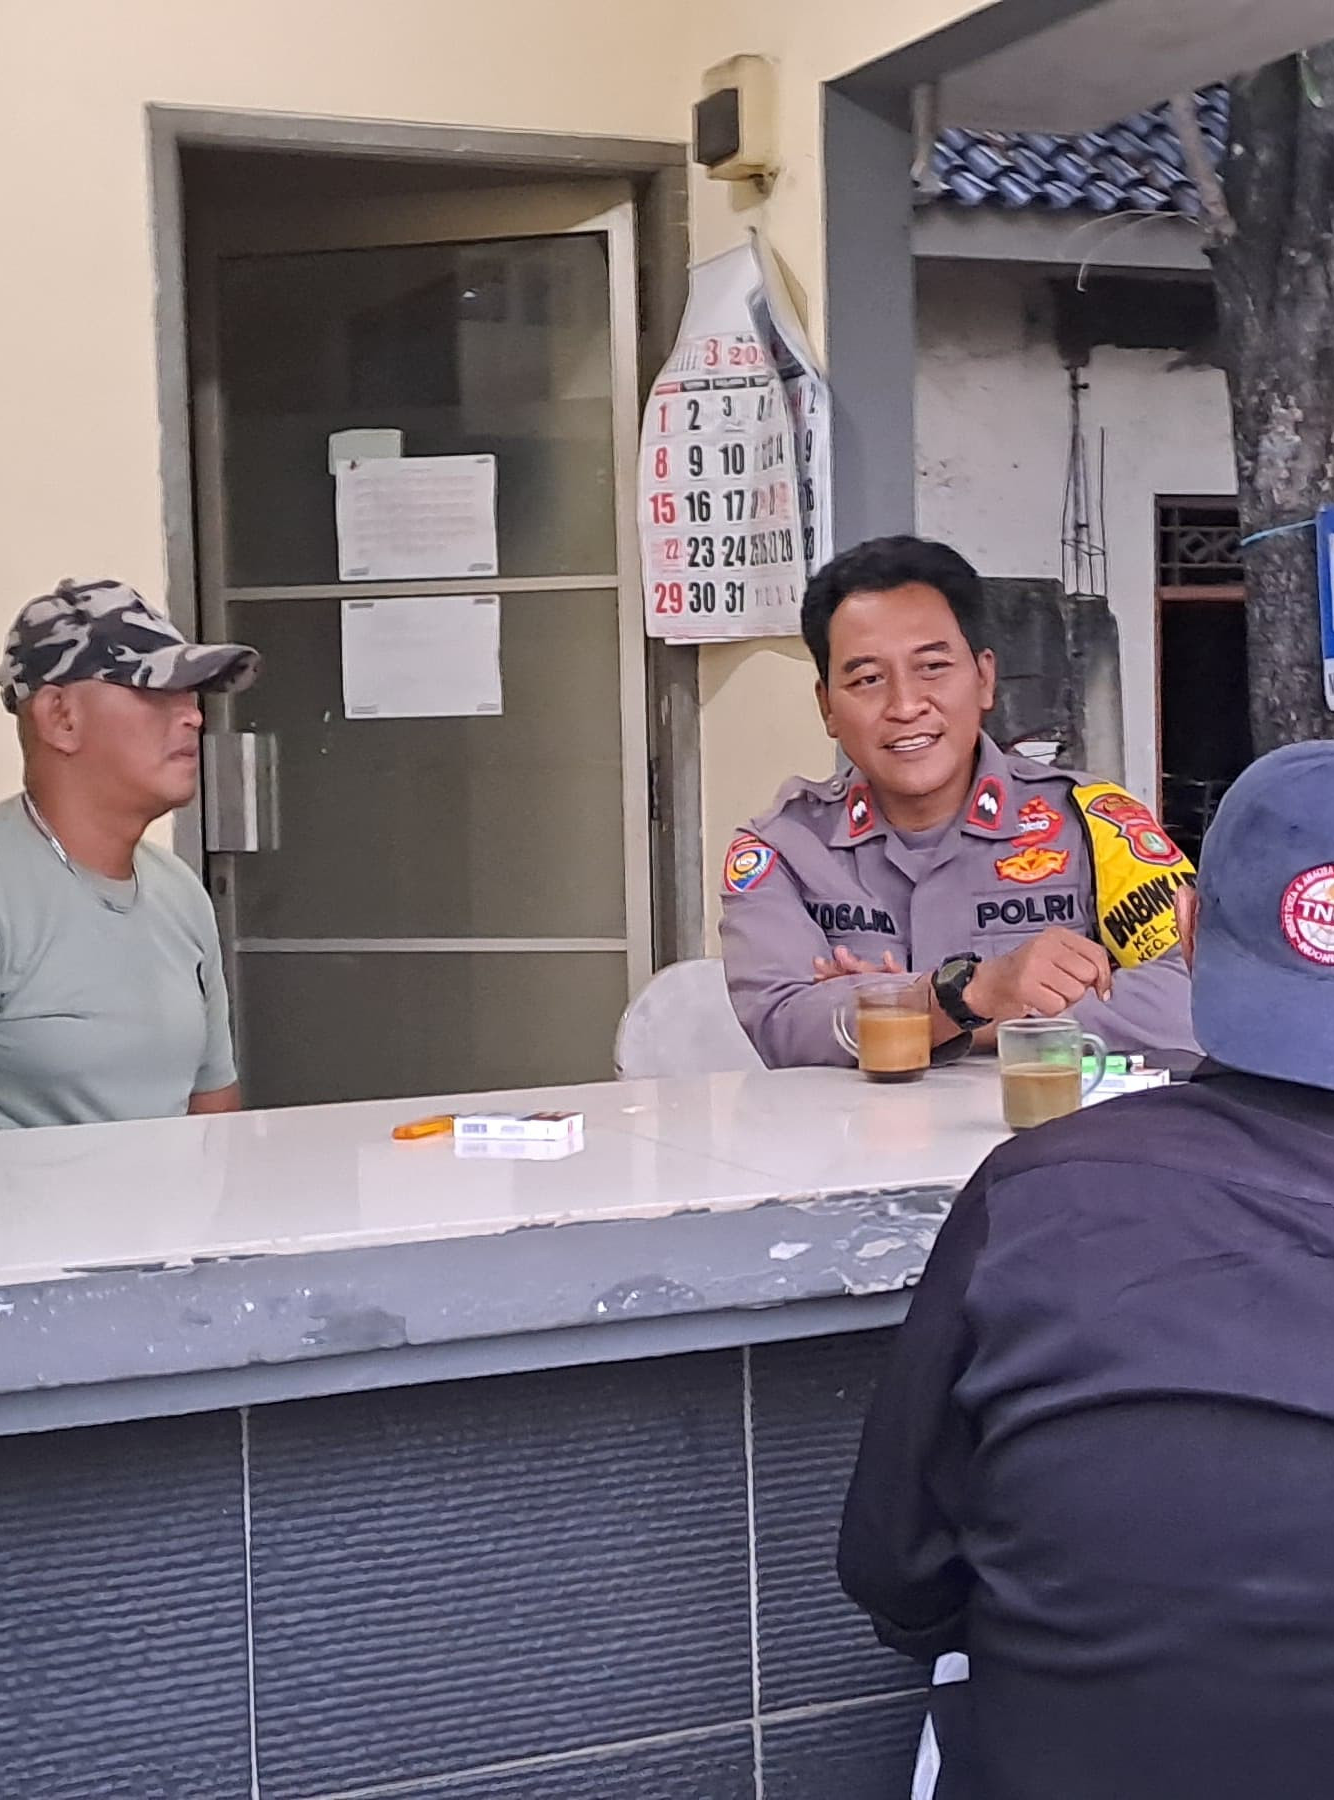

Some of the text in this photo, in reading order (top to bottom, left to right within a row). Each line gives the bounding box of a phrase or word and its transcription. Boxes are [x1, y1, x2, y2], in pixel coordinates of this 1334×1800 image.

[728, 345, 765, 366] 20
[659, 403, 669, 432] 1
[687, 399, 702, 430] 2
[722, 395, 732, 417] 3
[654, 444, 668, 479] 8
[688, 444, 703, 477] 9
[718, 443, 745, 475] 10
[649, 492, 676, 524] 15
[684, 490, 711, 523] 16
[723, 489, 746, 521] 17
[686, 536, 715, 568] 23
[722, 535, 746, 567] 24
[778, 528, 793, 562] 28
[654, 581, 683, 614] 29
[688, 581, 716, 613] 30
[724, 581, 745, 613] 31
[977, 893, 1074, 928] POLRI
